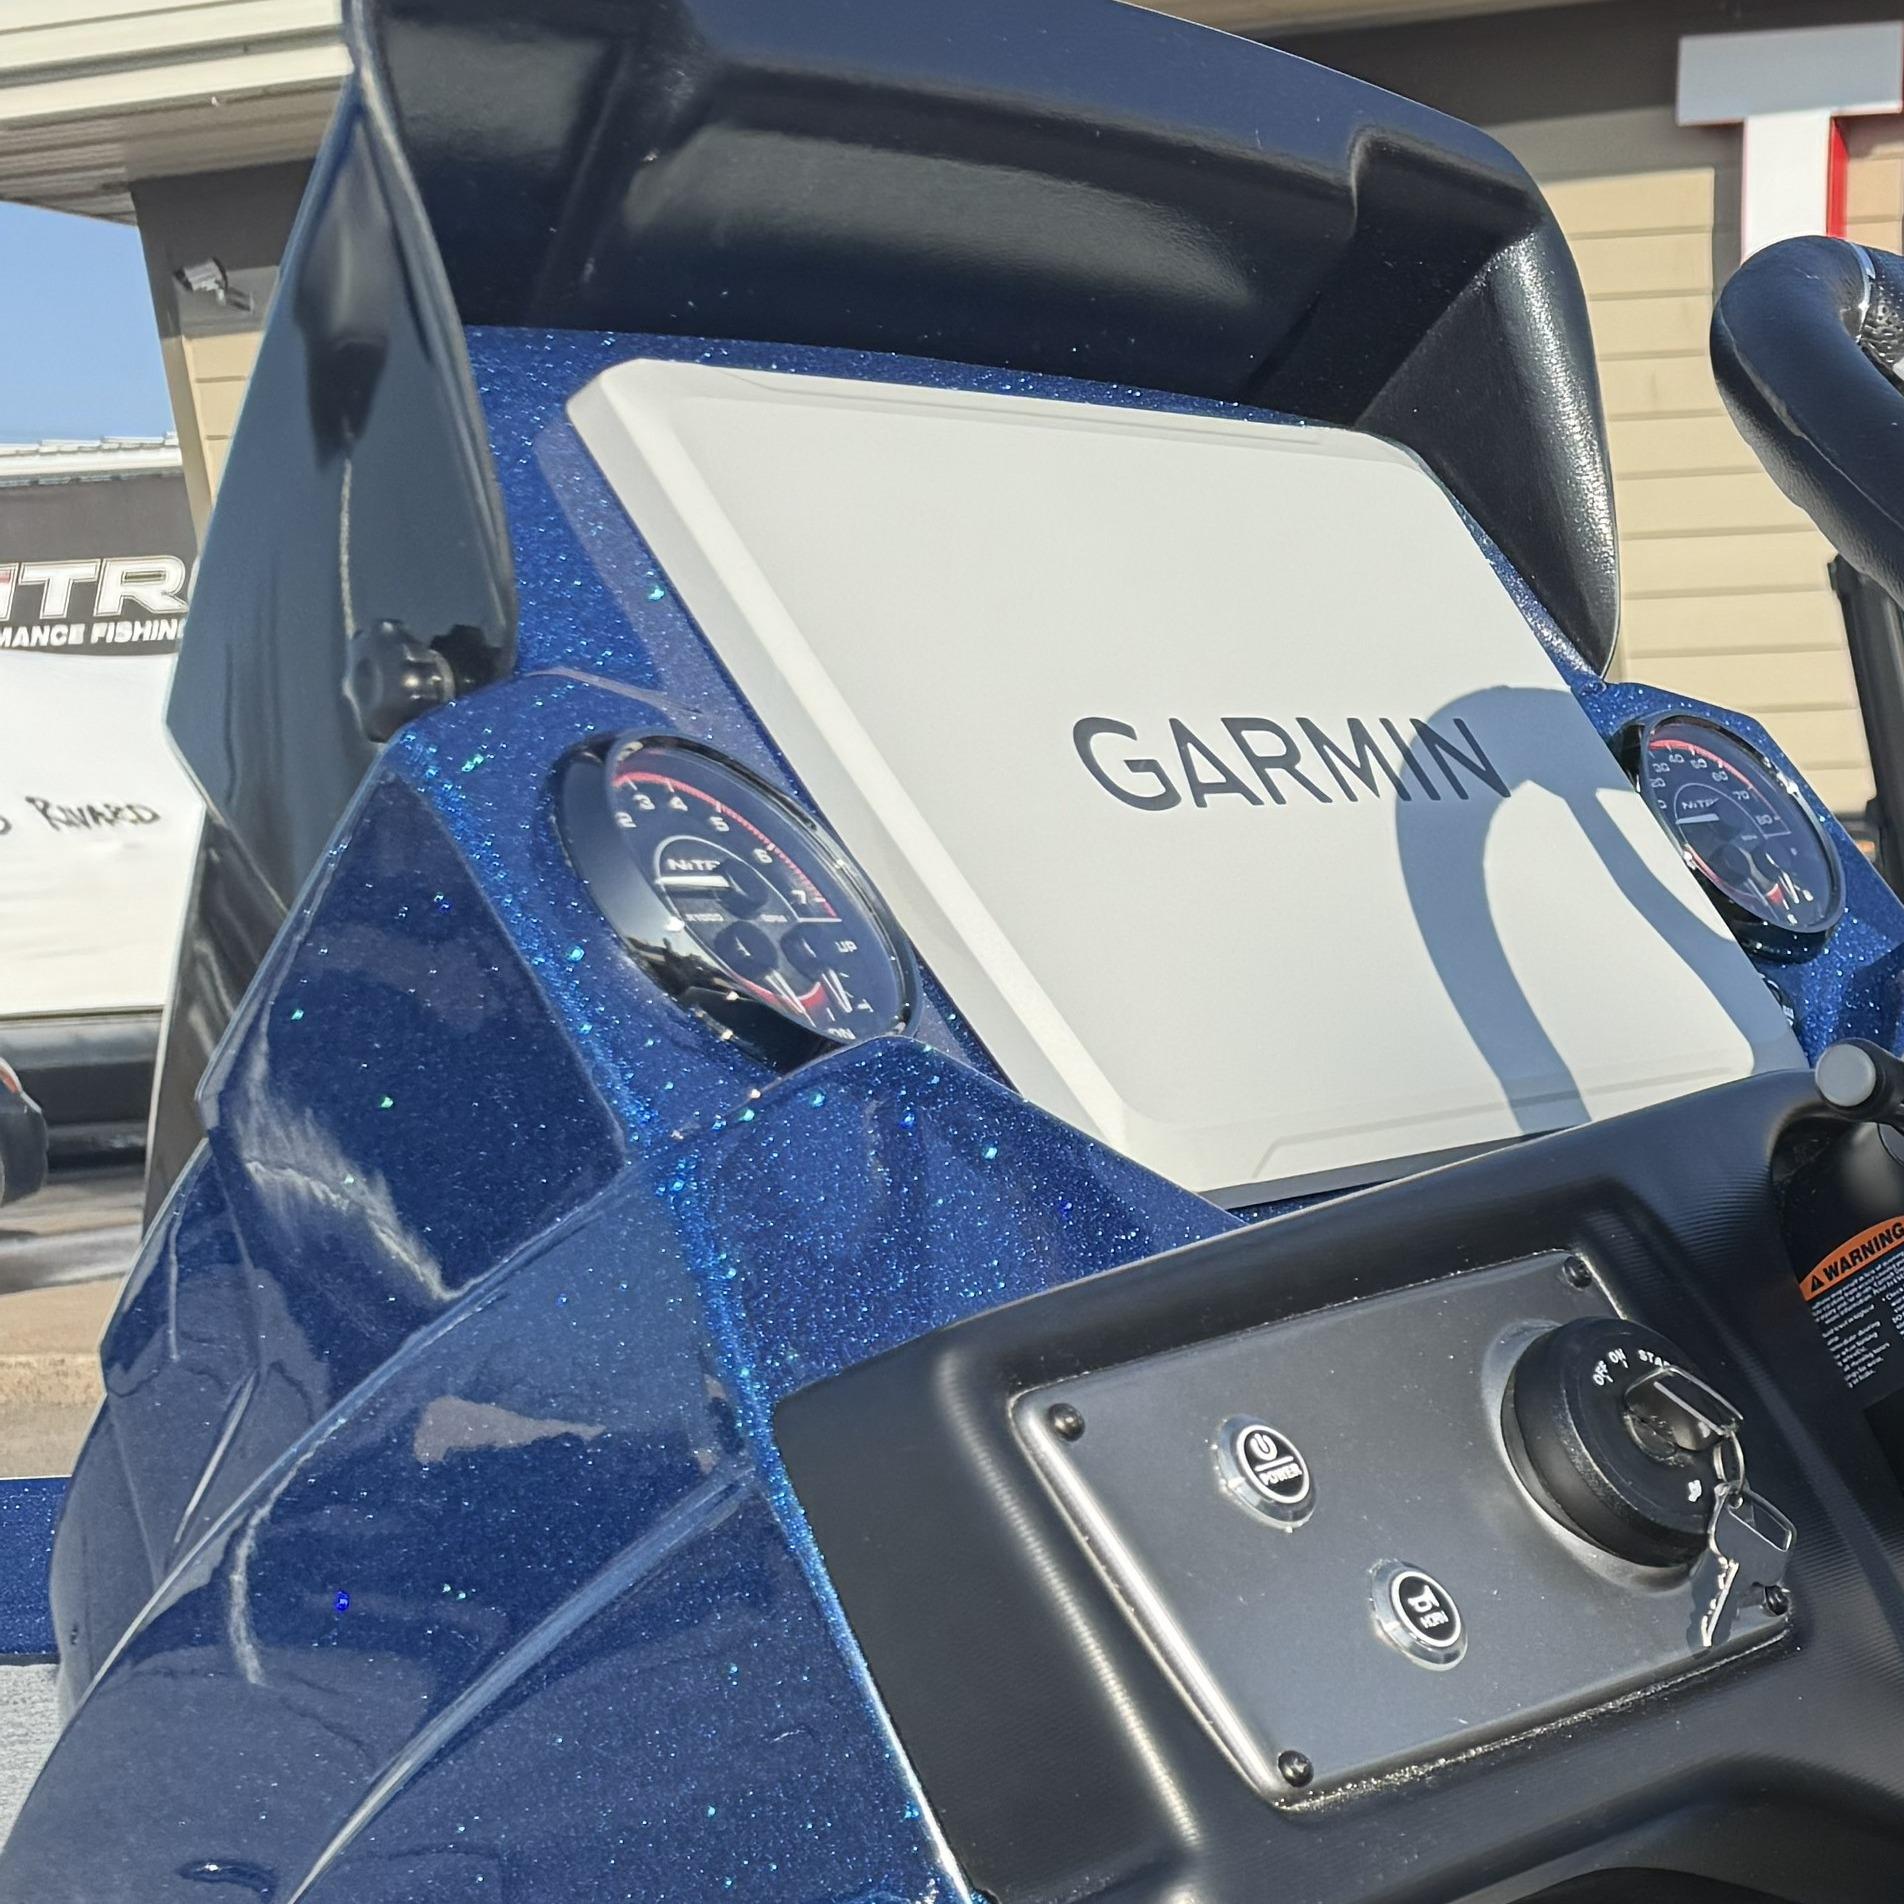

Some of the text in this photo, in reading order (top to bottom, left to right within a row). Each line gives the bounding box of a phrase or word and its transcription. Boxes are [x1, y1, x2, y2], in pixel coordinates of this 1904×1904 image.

[1072, 716, 1511, 811] GARMIN
[633, 794, 655, 811] 3
[669, 796, 688, 812] 4
[709, 816, 730, 832] 5
[752, 848, 773, 864] 6
[791, 889, 807, 905] 7
[1607, 1348, 1627, 1364] ON
[1592, 1360, 1609, 1386] OFF
[1258, 1462, 1304, 1487] POWER
[1418, 1610, 1450, 1629] HORN
